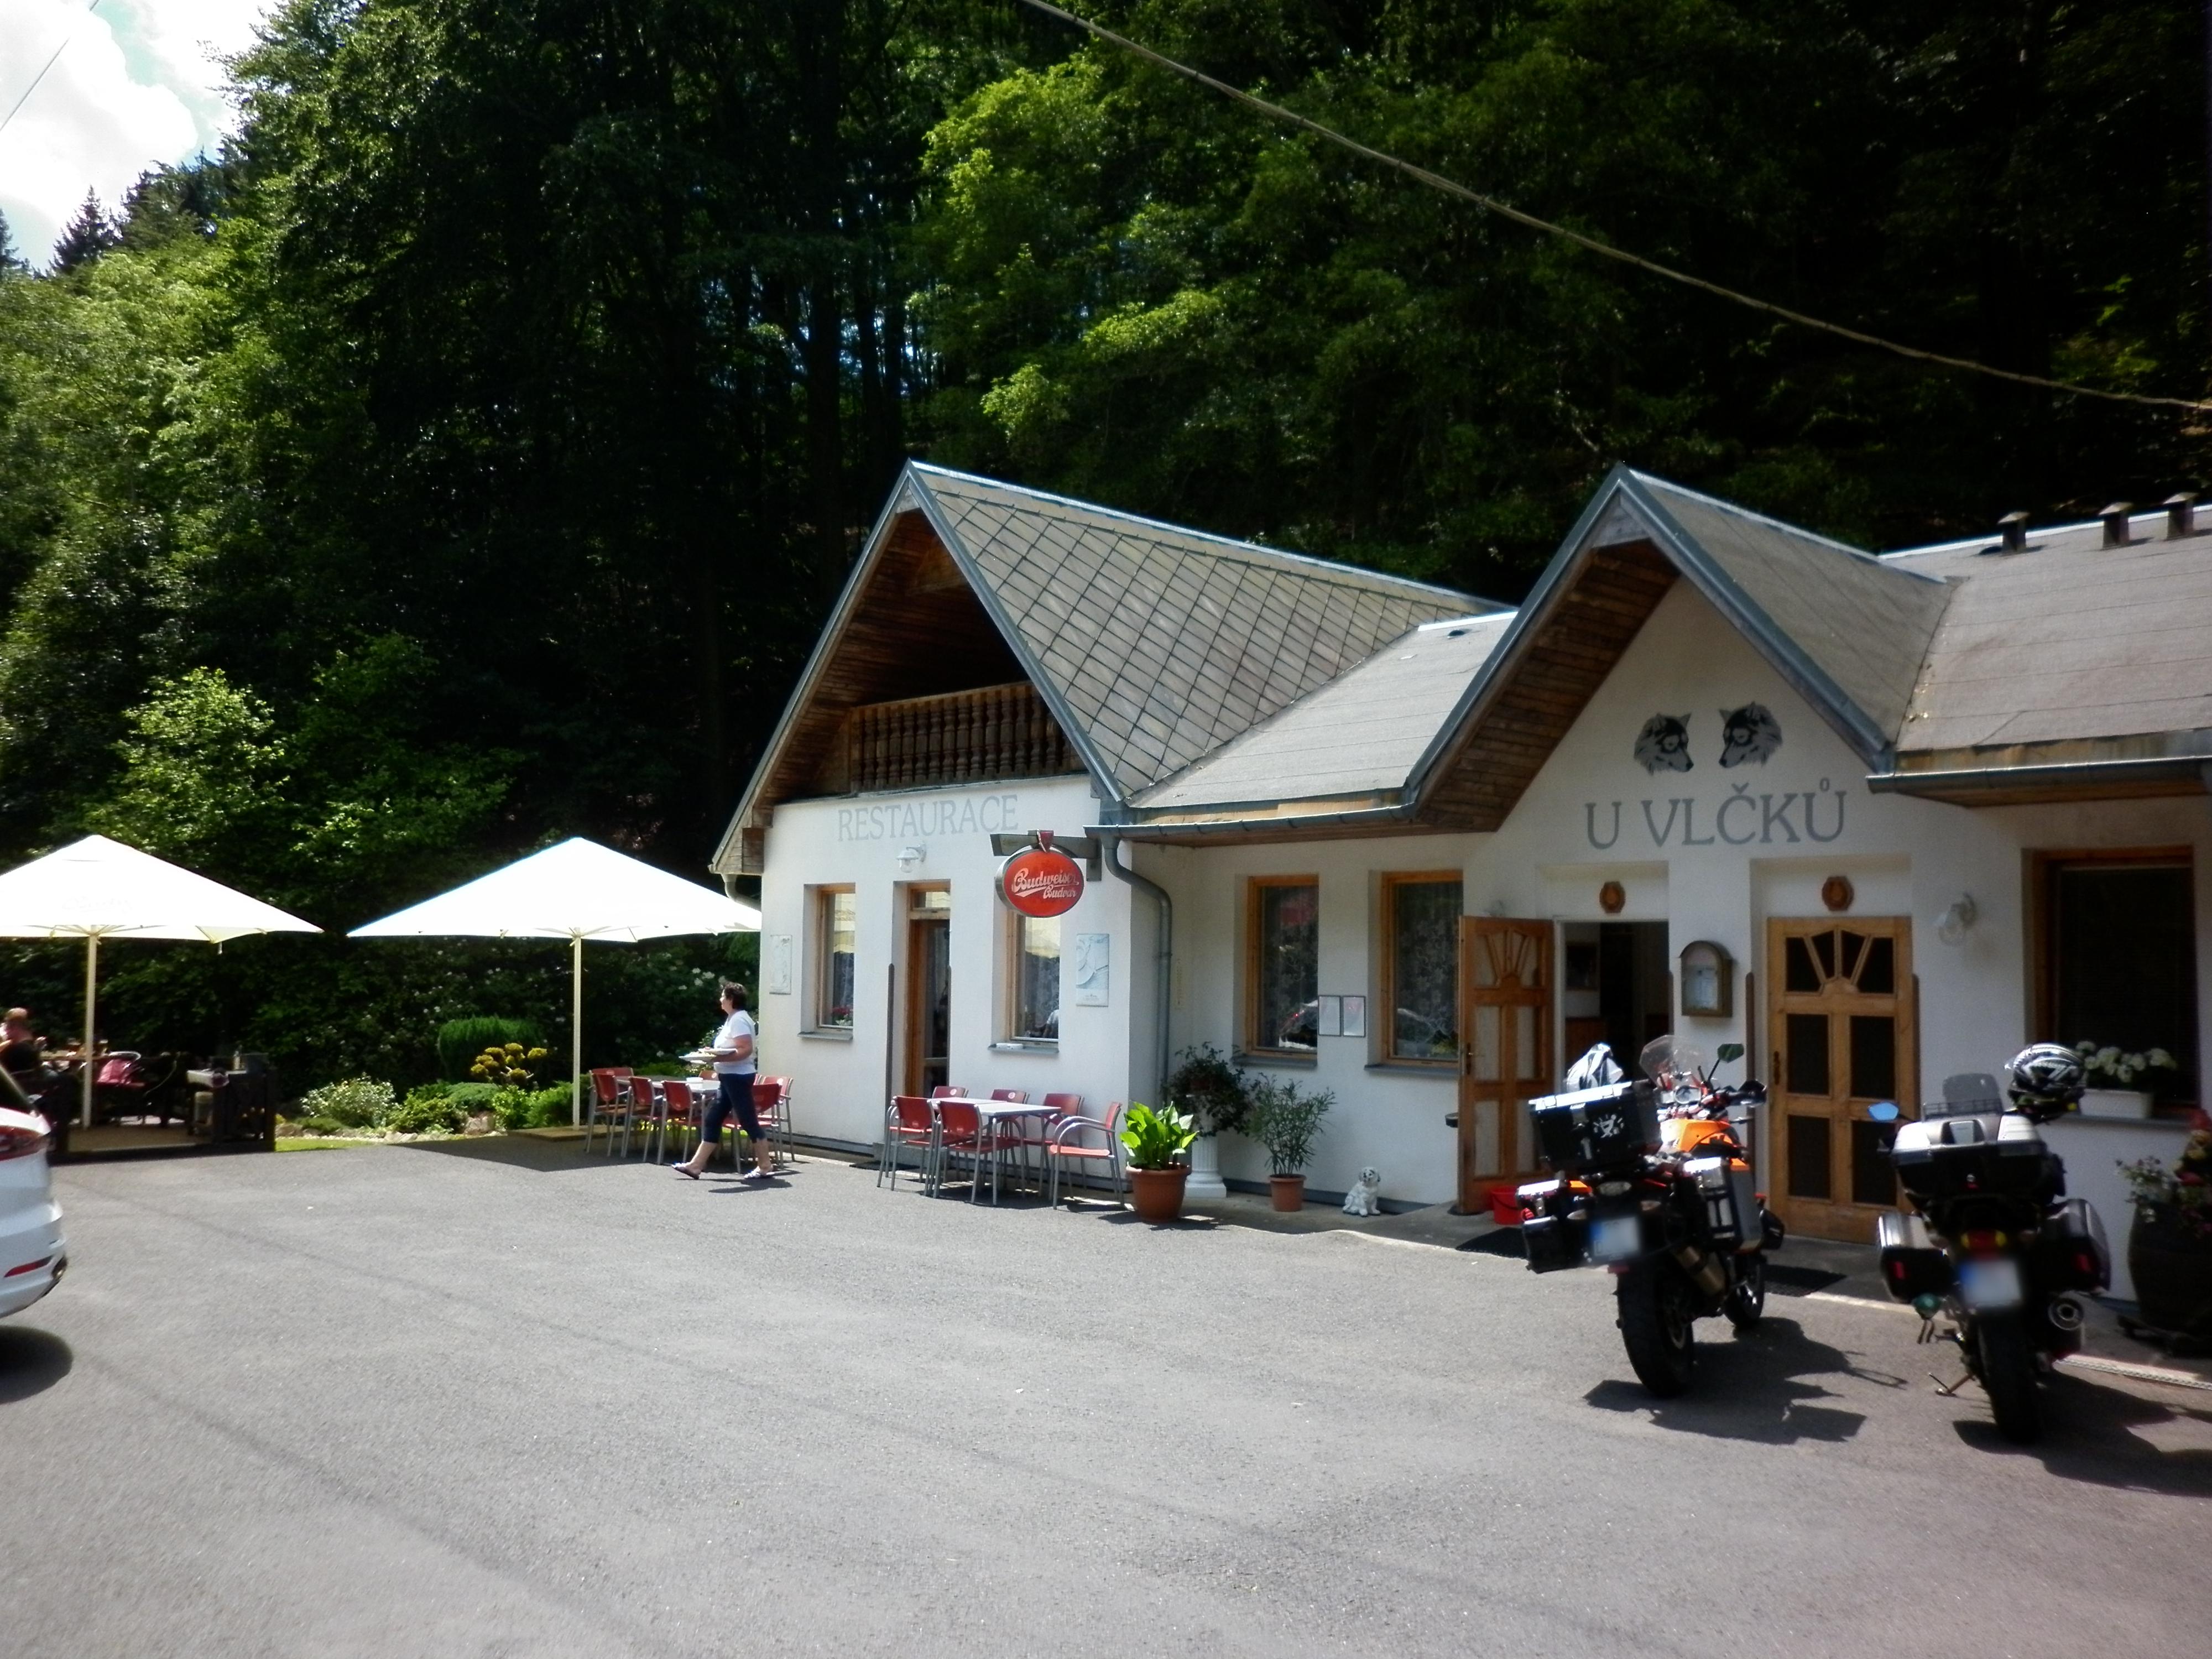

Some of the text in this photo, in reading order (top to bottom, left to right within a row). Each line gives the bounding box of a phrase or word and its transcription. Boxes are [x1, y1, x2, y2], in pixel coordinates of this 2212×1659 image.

[837, 794, 1019, 842] RESTAURACE
[1585, 777, 1847, 850] U VLČKŮ
[1011, 867, 1079, 893] Budweiser
[1043, 884, 1077, 899] Budvar
